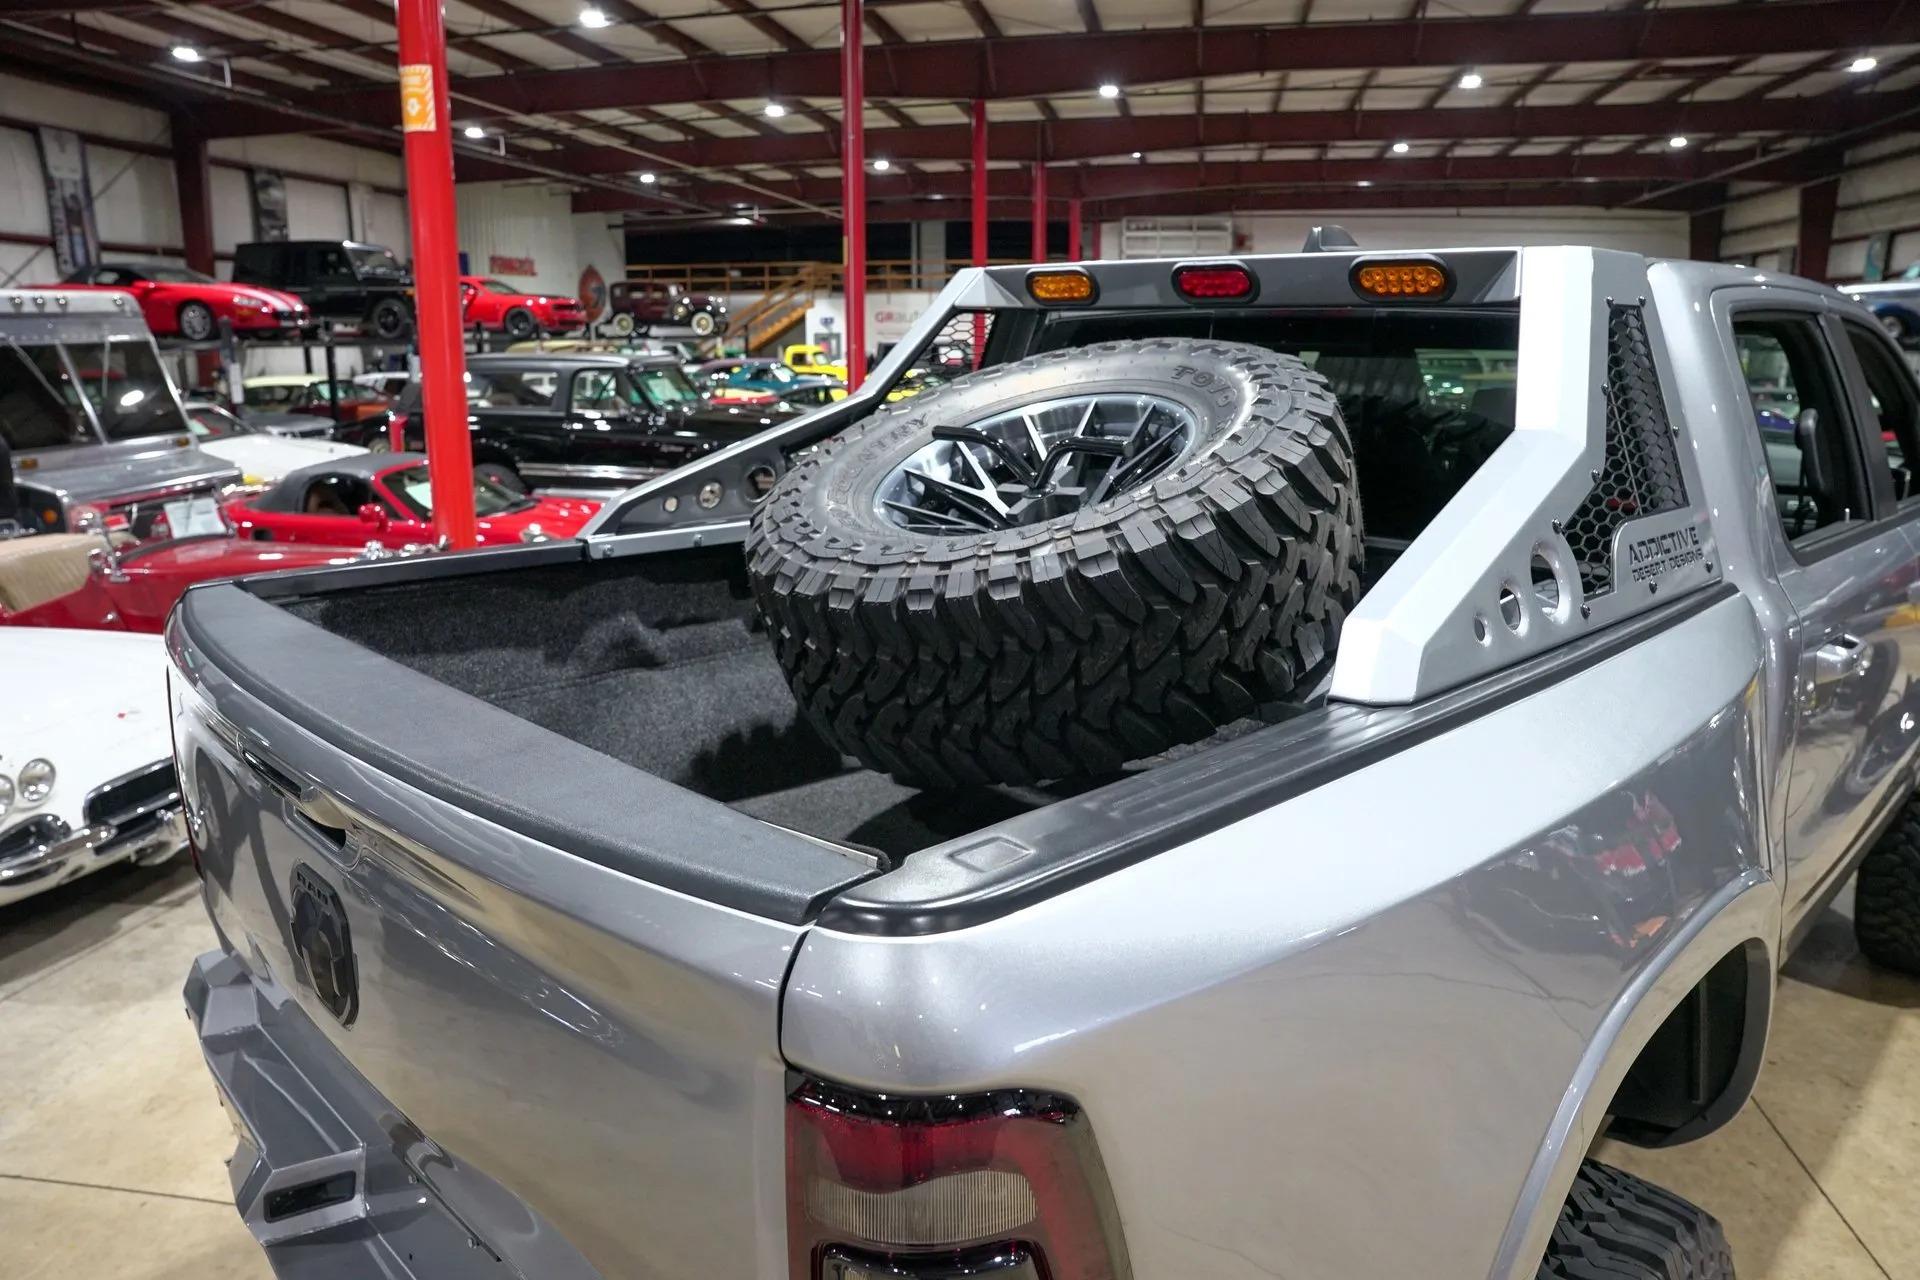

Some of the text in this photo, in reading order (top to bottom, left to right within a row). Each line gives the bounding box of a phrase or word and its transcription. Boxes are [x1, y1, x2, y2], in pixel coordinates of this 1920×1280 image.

[1171, 365, 1238, 407] TOYO
[1628, 526, 1700, 566] ADDICTIVE
[1632, 547, 1704, 583] DESERT DESIGNS
[296, 871, 329, 906] RAM
